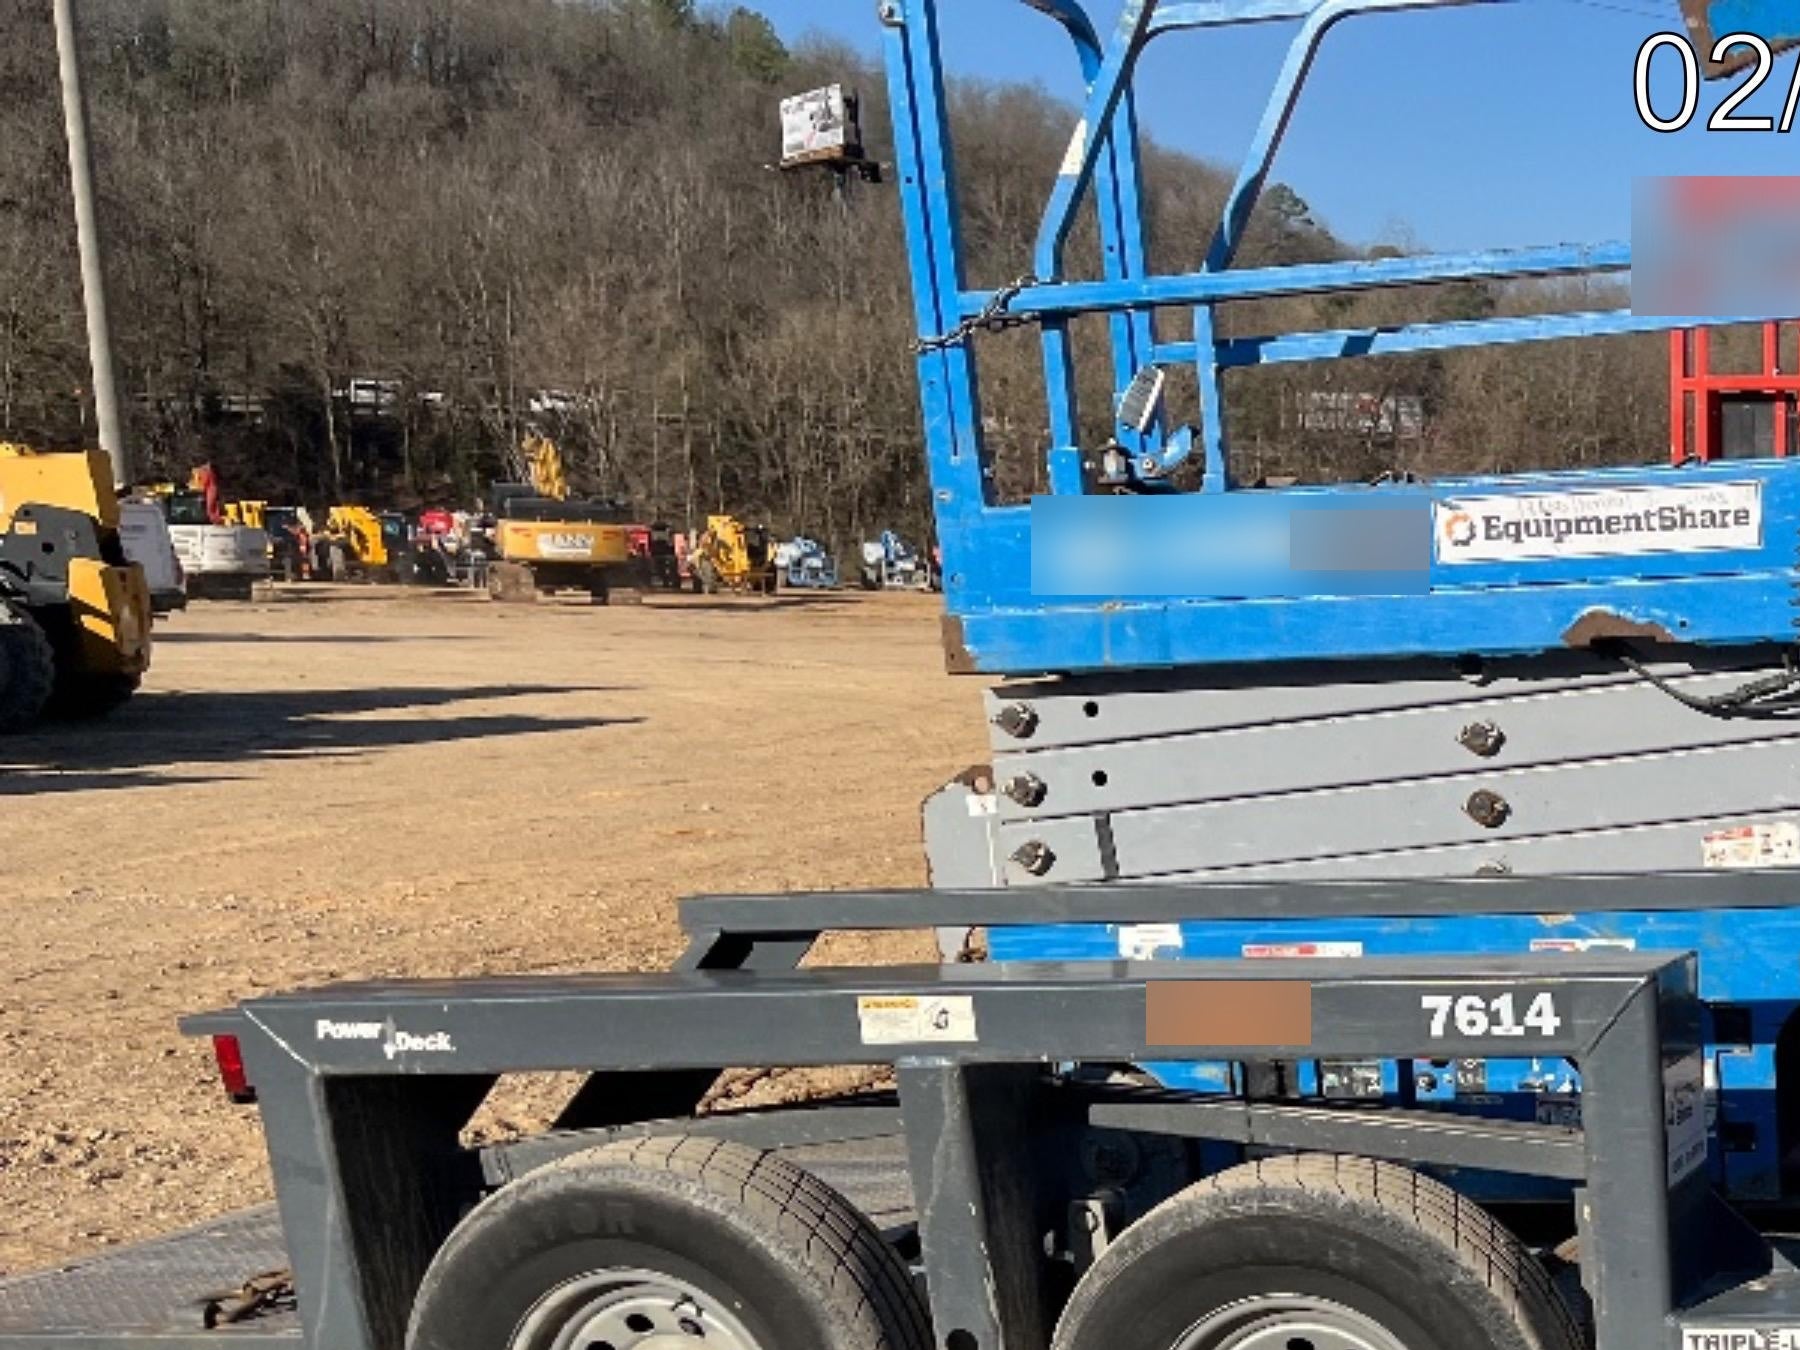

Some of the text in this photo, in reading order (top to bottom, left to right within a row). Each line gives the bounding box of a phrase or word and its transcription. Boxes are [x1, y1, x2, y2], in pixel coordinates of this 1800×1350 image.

[1482, 505, 1750, 544] EquipmentShare
[316, 1019, 383, 1040] Power
[1421, 991, 1562, 1038] 7614
